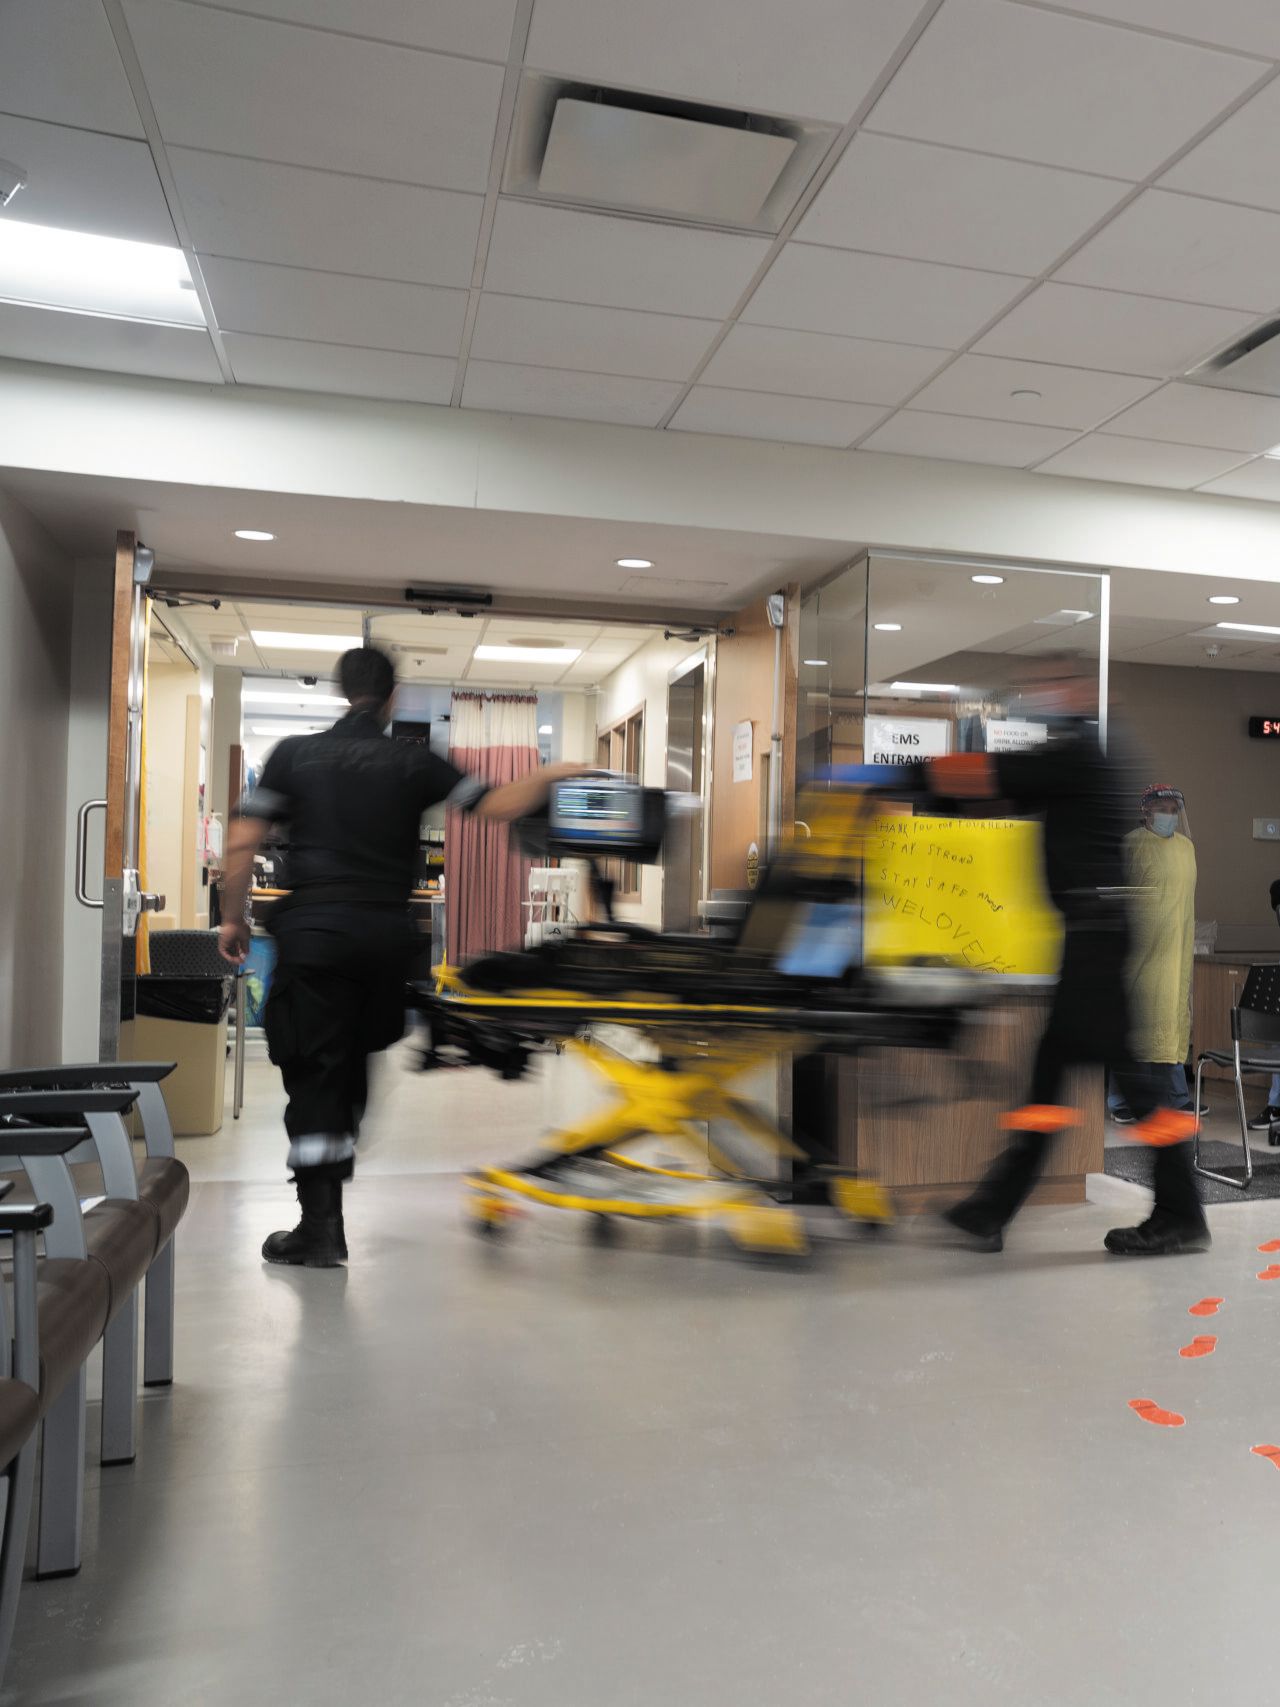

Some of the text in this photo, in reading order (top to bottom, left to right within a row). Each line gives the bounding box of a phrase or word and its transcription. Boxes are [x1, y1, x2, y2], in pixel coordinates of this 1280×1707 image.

[892, 734, 920, 745] EMS
[881, 840, 916, 856] STAY
[880, 868, 918, 888] STAY
